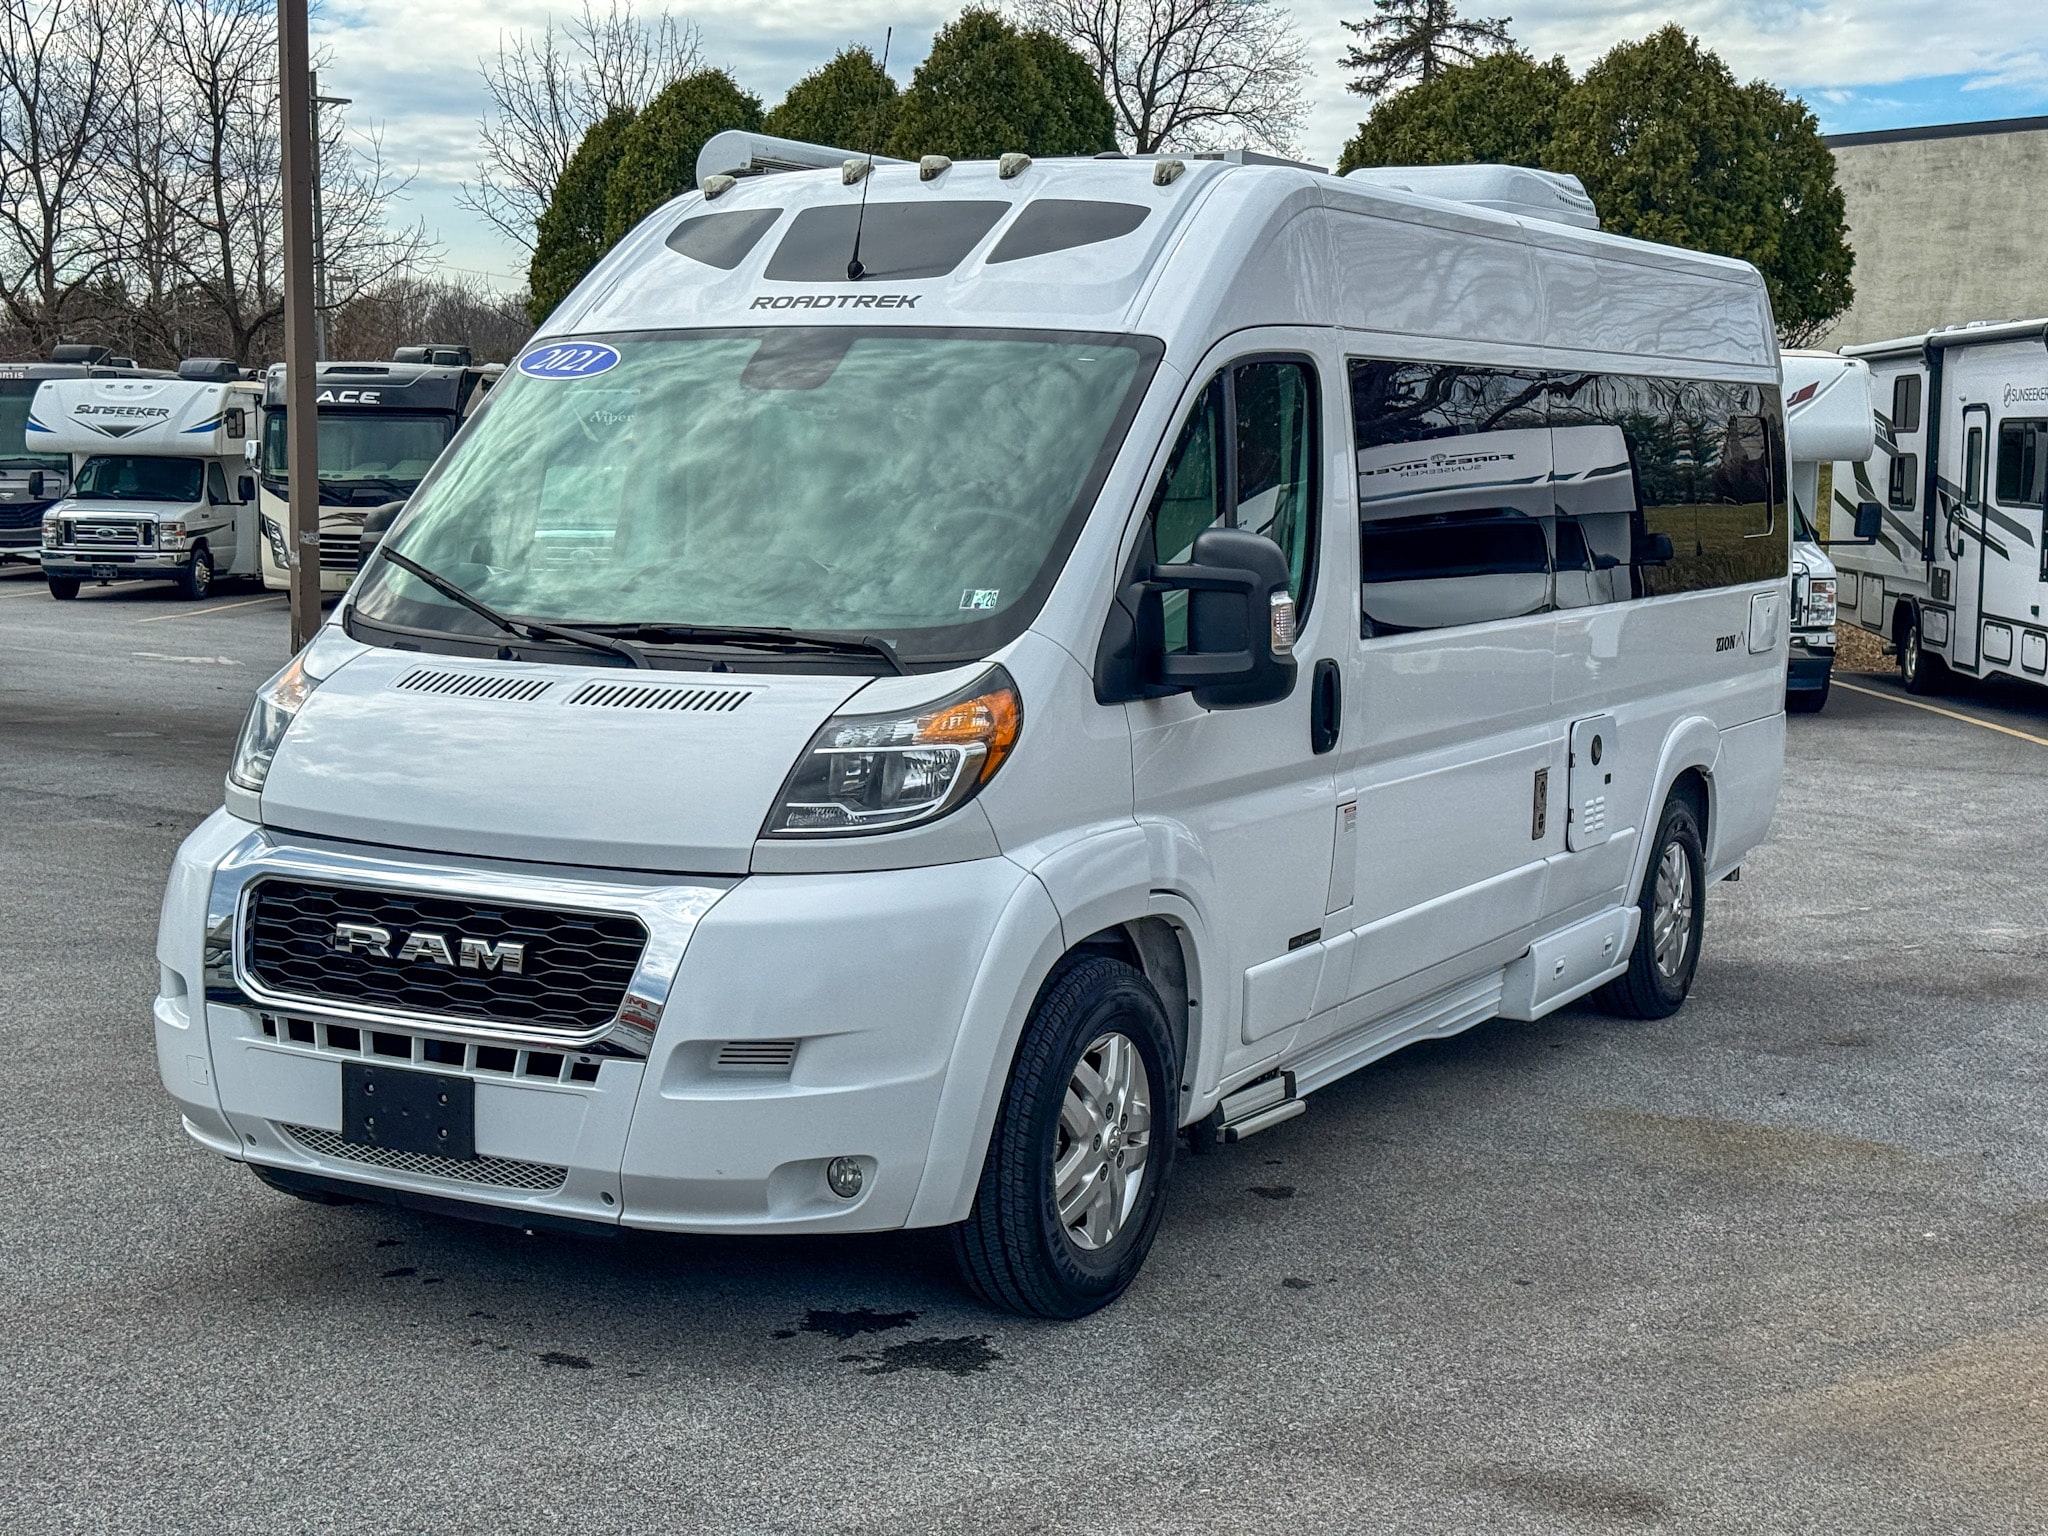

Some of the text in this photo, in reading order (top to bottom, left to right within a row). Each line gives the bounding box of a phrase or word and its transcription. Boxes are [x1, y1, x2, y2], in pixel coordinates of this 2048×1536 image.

[749, 295, 923, 310] ROADTREK
[527, 349, 608, 372] 2021
[74, 404, 169, 420] SUNSEEKER
[1715, 634, 1736, 652] ZION
[335, 923, 525, 974] RAM
